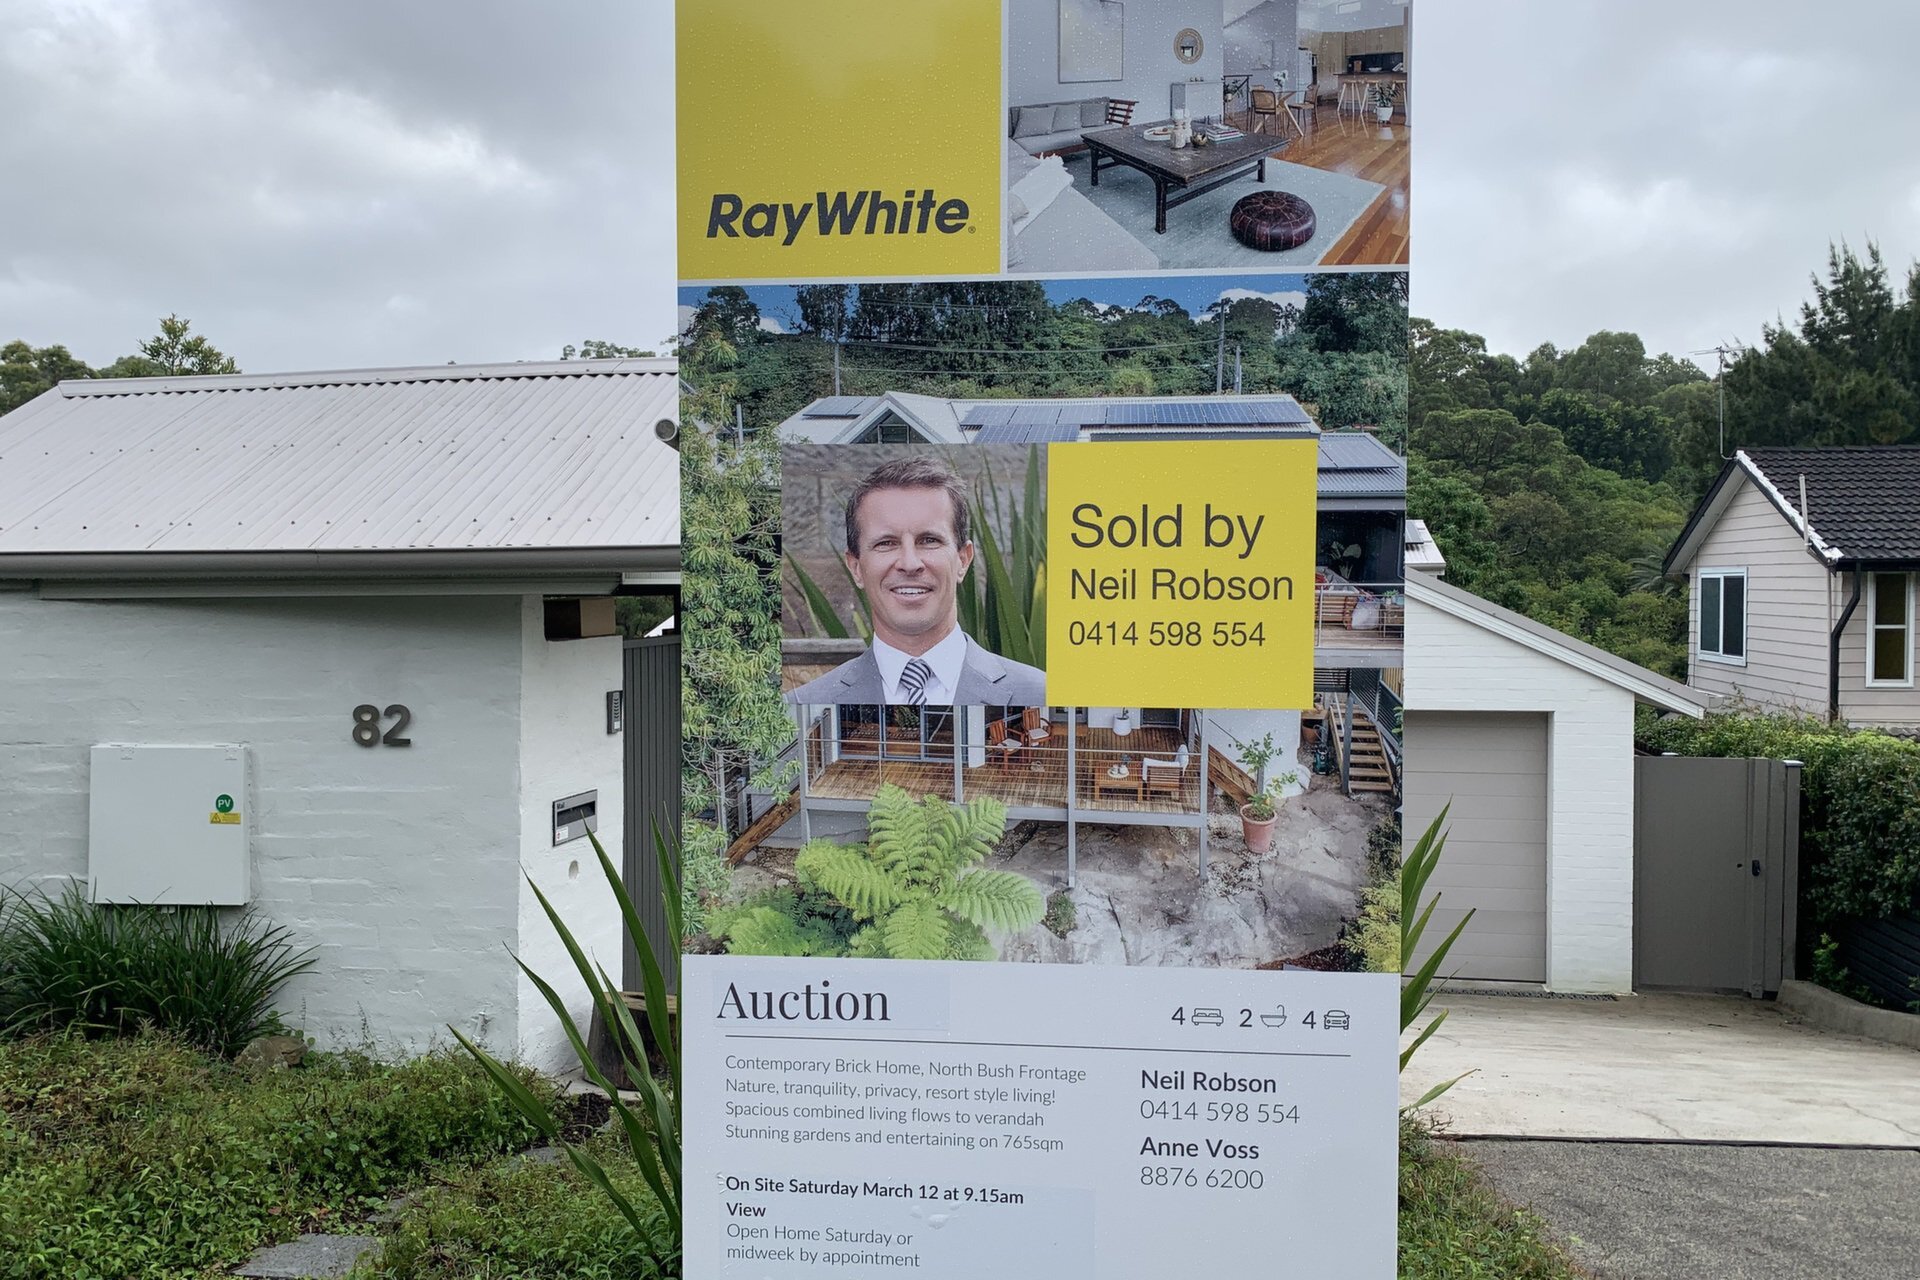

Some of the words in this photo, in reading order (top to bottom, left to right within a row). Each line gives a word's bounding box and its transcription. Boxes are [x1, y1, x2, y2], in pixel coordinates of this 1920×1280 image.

[1070, 503, 1183, 549] Sold
[1204, 503, 1265, 560] by
[1071, 568, 1136, 601] Neil
[1152, 568, 1293, 601] Robson
[1069, 620, 1139, 646] 0414
[1149, 621, 1202, 647] 598
[1212, 621, 1266, 647] 554
[352, 704, 412, 749] 82
[217, 799, 231, 808] PV
[716, 979, 891, 1021] Auction
[1171, 1005, 1186, 1026] 4
[1238, 1007, 1253, 1028] 2
[1302, 1009, 1317, 1030] 4
[725, 1054, 831, 1075] Contemporary
[835, 1058, 872, 1074] Brick
[876, 1059, 925, 1078] Home,
[929, 1061, 973, 1077] North
[977, 1062, 1014, 1079] Bush
[1019, 1064, 1087, 1084] Frontage
[1141, 1069, 1185, 1091] Neil
[1193, 1071, 1277, 1094] Robson
[725, 1077, 780, 1096] Nature,
[783, 1080, 861, 1100] tranquility,
[865, 1082, 921, 1102] privacy,
[925, 1086, 970, 1101] resort
[973, 1087, 1009, 1104] style
[1012, 1087, 1056, 1107] living!
[725, 1100, 790, 1119] Spacious
[792, 1104, 865, 1120] combined
[869, 1105, 908, 1125] living
[911, 1107, 951, 1124] flows
[954, 1109, 971, 1124] to
[974, 1111, 1044, 1127] verandah
[1140, 1099, 1199, 1121] 0414
[1206, 1101, 1249, 1123] 598
[1257, 1103, 1301, 1124] 554
[725, 1123, 790, 1144] Stunning
[793, 1127, 851, 1144] gardens
[854, 1129, 882, 1144] and
[885, 1131, 976, 1151] entertaining
[978, 1136, 999, 1149] on
[1002, 1134, 1064, 1153] 765sqm
[1139, 1136, 1199, 1158] Anne
[1205, 1138, 1260, 1160] Voss
[725, 1175, 750, 1191] On
[754, 1177, 785, 1193] Site
[788, 1178, 859, 1199] Saturday
[863, 1181, 913, 1199] March
[918, 1184, 939, 1200] 12
[943, 1187, 960, 1201] at
[963, 1186, 1024, 1205] 9.15am
[1140, 1165, 1198, 1188] 8876
[1205, 1168, 1264, 1190] 6200
[725, 1201, 767, 1218] View
[726, 1222, 769, 1241] Open
[774, 1224, 821, 1242] Home
[825, 1226, 893, 1248] Saturday
[896, 1234, 914, 1246] or
[727, 1244, 795, 1261] midweek
[799, 1247, 819, 1265] by
[822, 1249, 921, 1268] appointment
